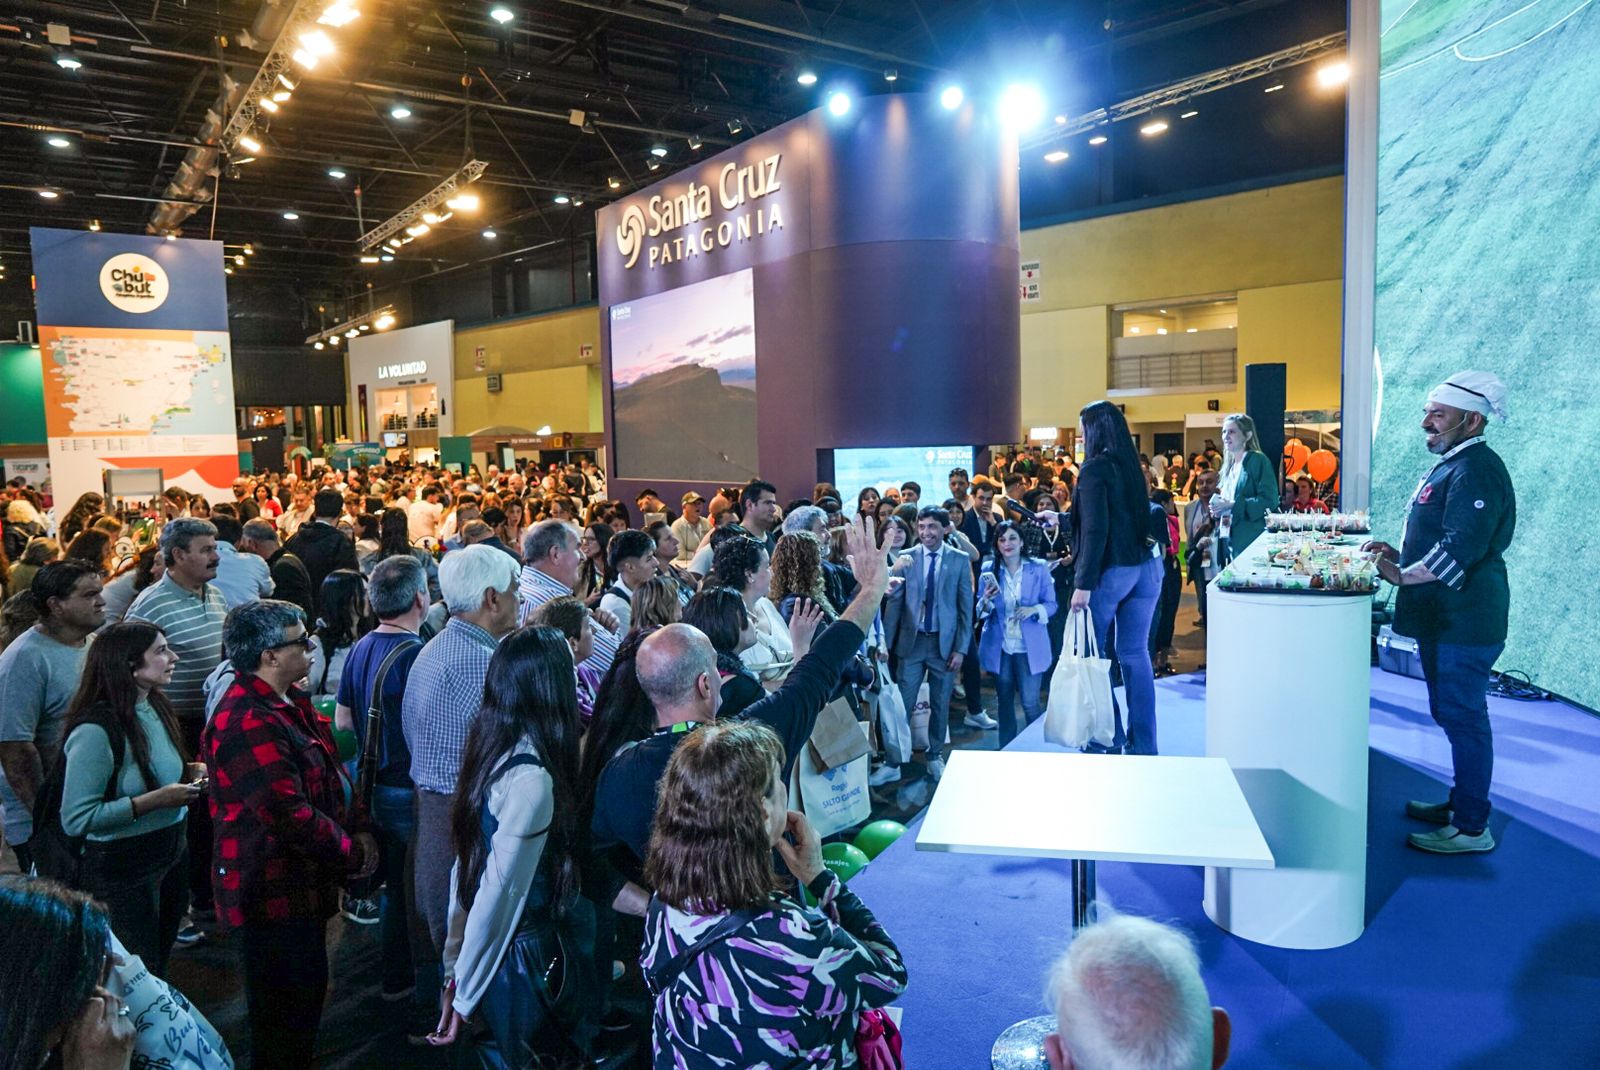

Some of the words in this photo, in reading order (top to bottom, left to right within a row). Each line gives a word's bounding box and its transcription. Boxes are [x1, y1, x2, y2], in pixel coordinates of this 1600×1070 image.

[648, 182, 712, 238] Santa
[719, 153, 782, 211] Cruz
[649, 203, 783, 269] PATAGONIA
[111, 269, 143, 282] Chu
[124, 280, 151, 293] but
[378, 367, 388, 379] LA
[388, 360, 427, 378] VOLUNTAD
